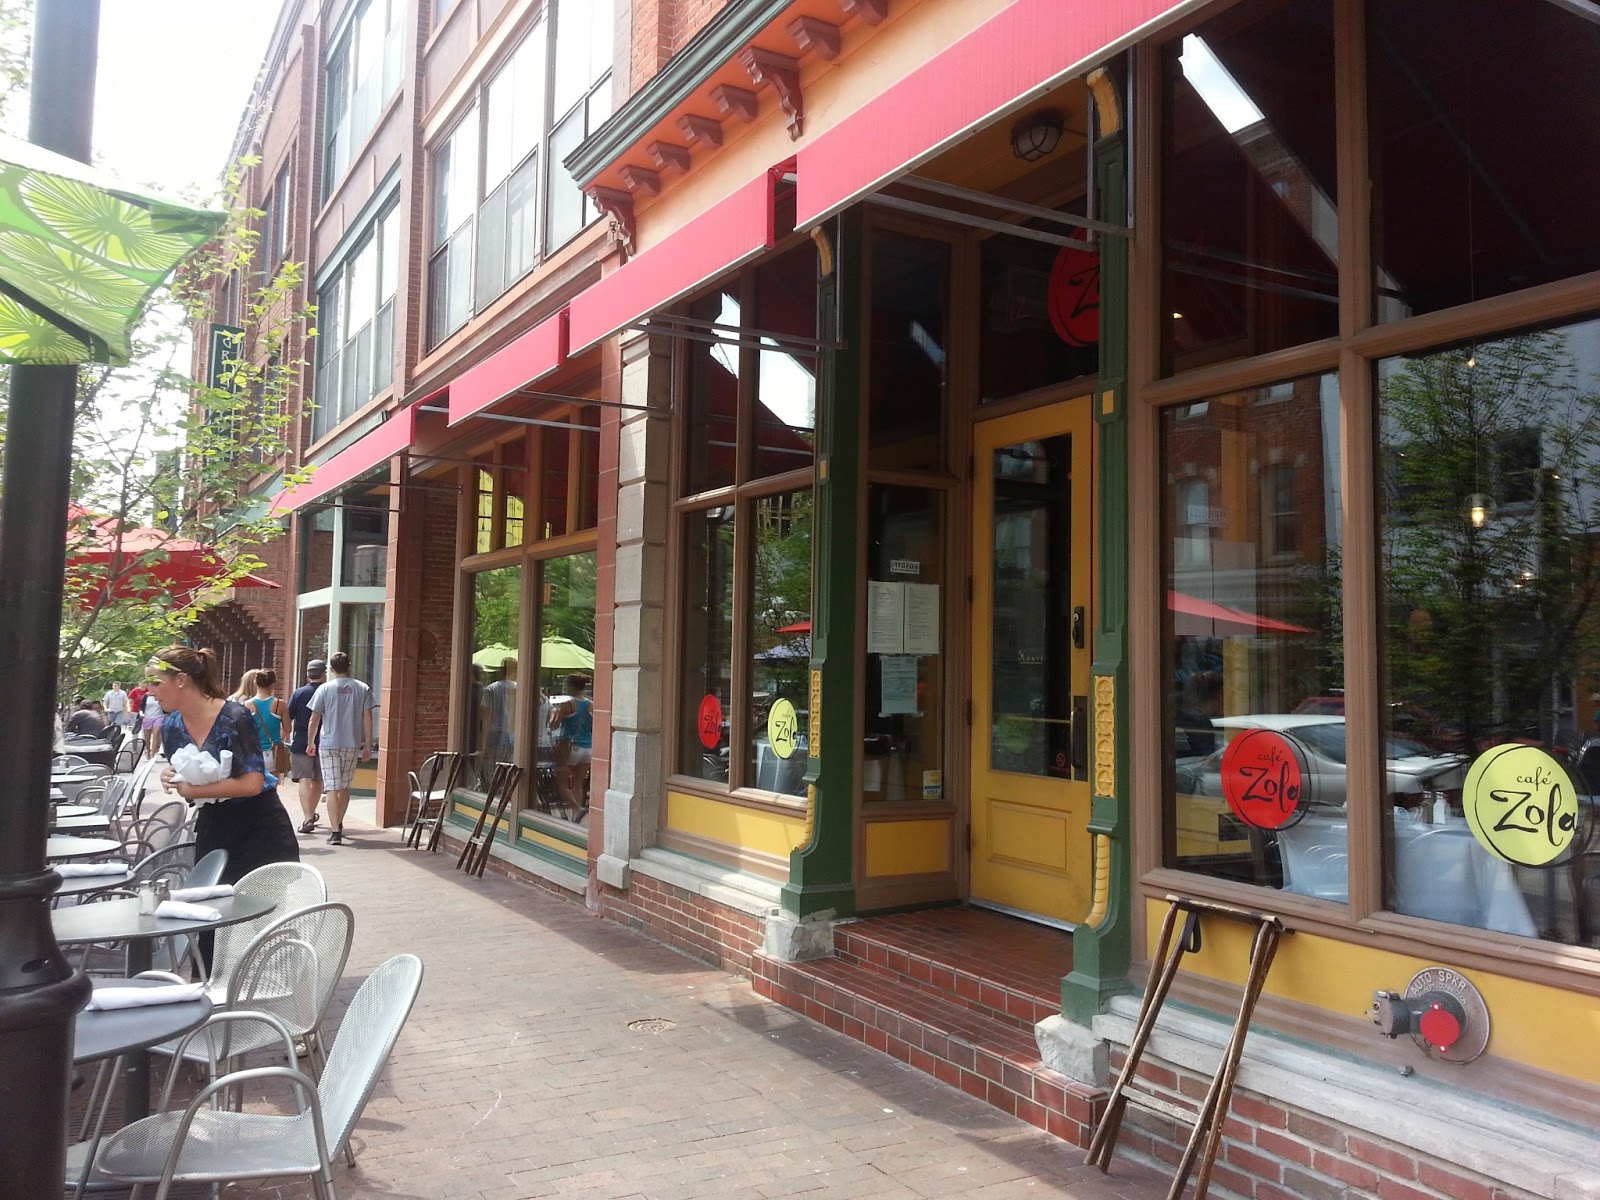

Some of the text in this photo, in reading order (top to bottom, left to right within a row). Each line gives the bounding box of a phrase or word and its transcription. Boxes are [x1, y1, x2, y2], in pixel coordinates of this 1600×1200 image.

[775, 716, 797, 748] Zola
[1258, 746, 1283, 767] café
[1239, 760, 1300, 813] Zola
[1516, 766, 1552, 791] café
[1489, 783, 1578, 847] Zola
[1410, 970, 1466, 996] AUTO SPKR
